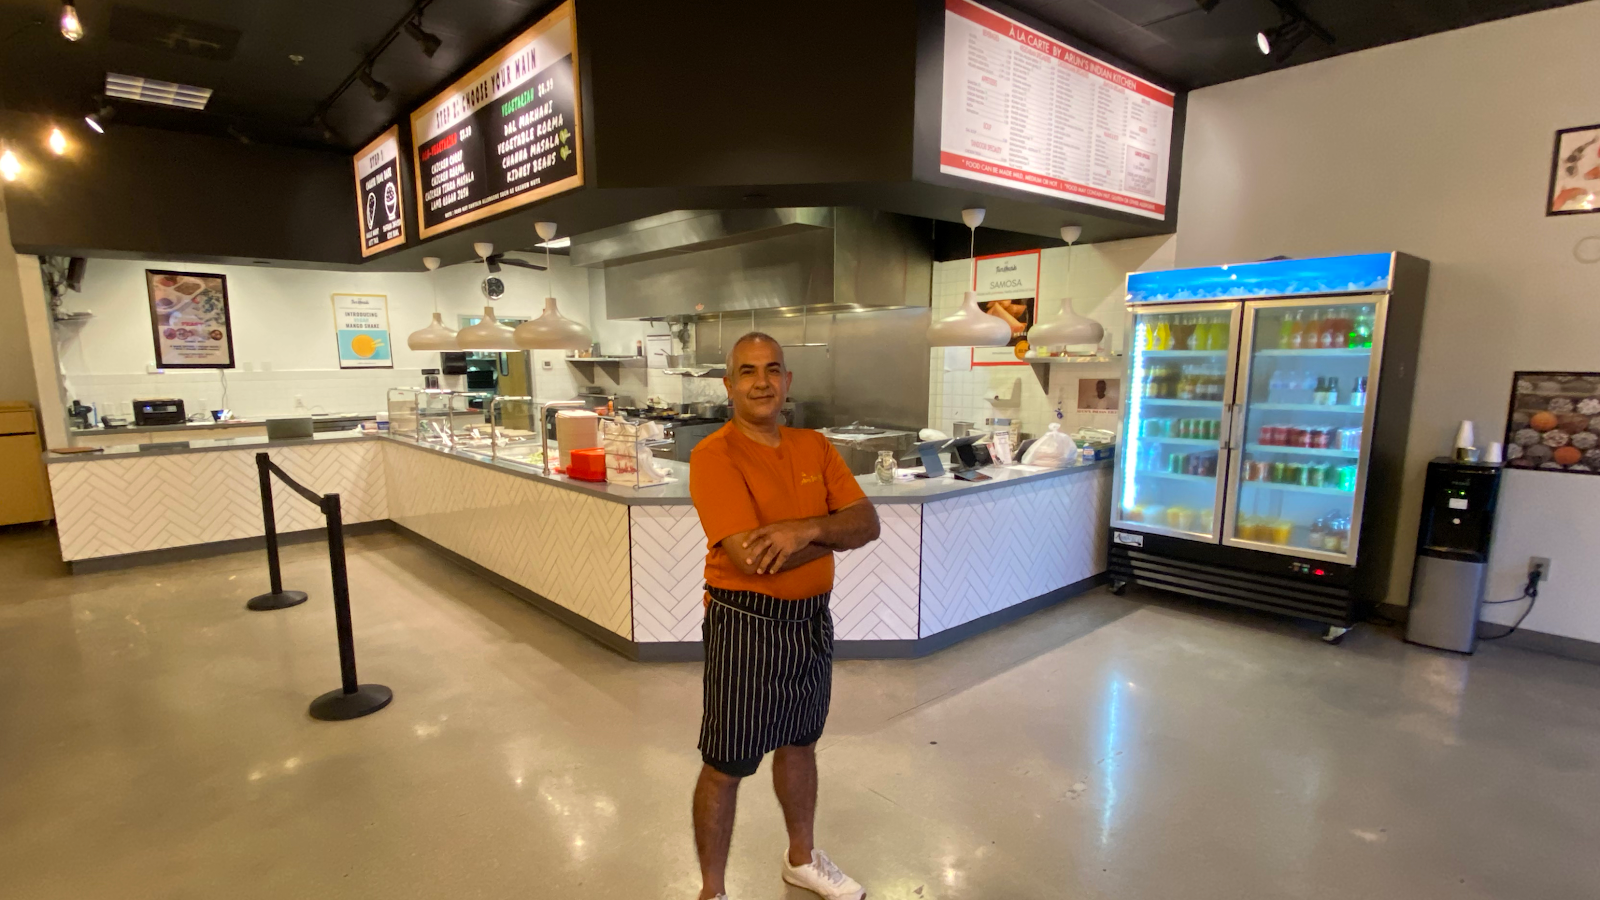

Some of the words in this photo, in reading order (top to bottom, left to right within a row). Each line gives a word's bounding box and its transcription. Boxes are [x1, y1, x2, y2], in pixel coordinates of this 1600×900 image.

[1017, 29, 1027, 43] LA
[1027, 34, 1050, 53] CARTE
[1052, 45, 1062, 58] BY
[1064, 51, 1089, 70] ARUN'S
[1090, 63, 1112, 81] INDIAN
[1113, 73, 1137, 91] KITCHEN
[436, 105, 450, 129] STEP
[462, 79, 488, 113] CHOOSE
[491, 65, 511, 94] YOUR
[515, 47, 537, 80] MAIN
[501, 86, 535, 118] VEGETARIAN
[503, 119, 517, 136] DAL
[518, 99, 553, 129] MAKHANI
[497, 126, 535, 156] VEGETABLE
[537, 113, 564, 137] KORMA
[369, 153, 380, 169] STEP
[502, 147, 528, 169] CHANNA
[530, 133, 560, 158] MASALA
[507, 162, 531, 183] KIDNEY
[533, 151, 557, 173] BEANS
[456, 171, 475, 188] MASALA
[965, 160, 980, 170] FOOD
[980, 163, 992, 172] CAN
[999, 168, 1013, 177] MADE
[990, 279, 1022, 290] SAMOSA
